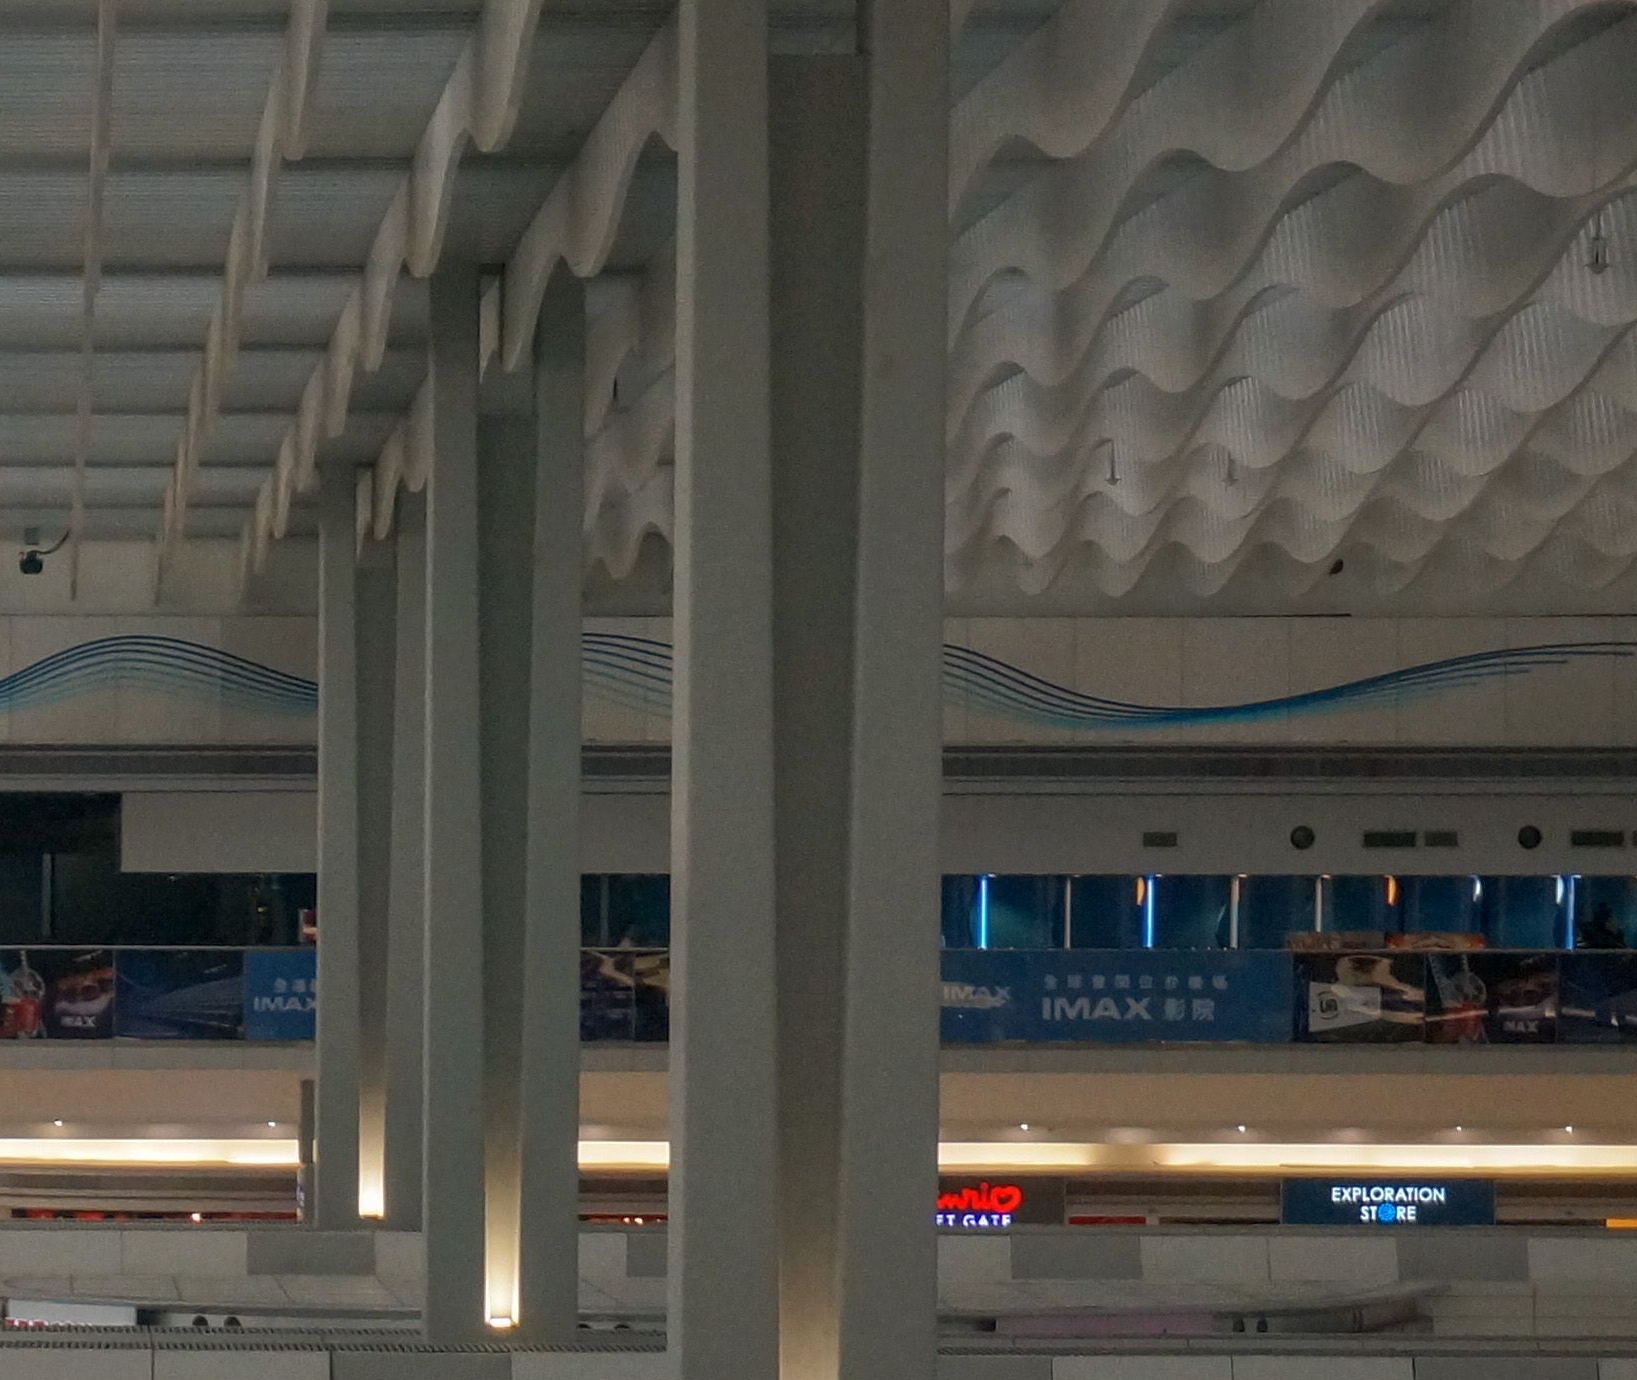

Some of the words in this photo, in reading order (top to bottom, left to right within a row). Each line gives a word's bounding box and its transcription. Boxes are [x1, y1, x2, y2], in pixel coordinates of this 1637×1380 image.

[1042, 998, 1152, 1021] IMAX
[1331, 1187, 1445, 1203] EXPLORATION
[1360, 1204, 1416, 1222] STORE
